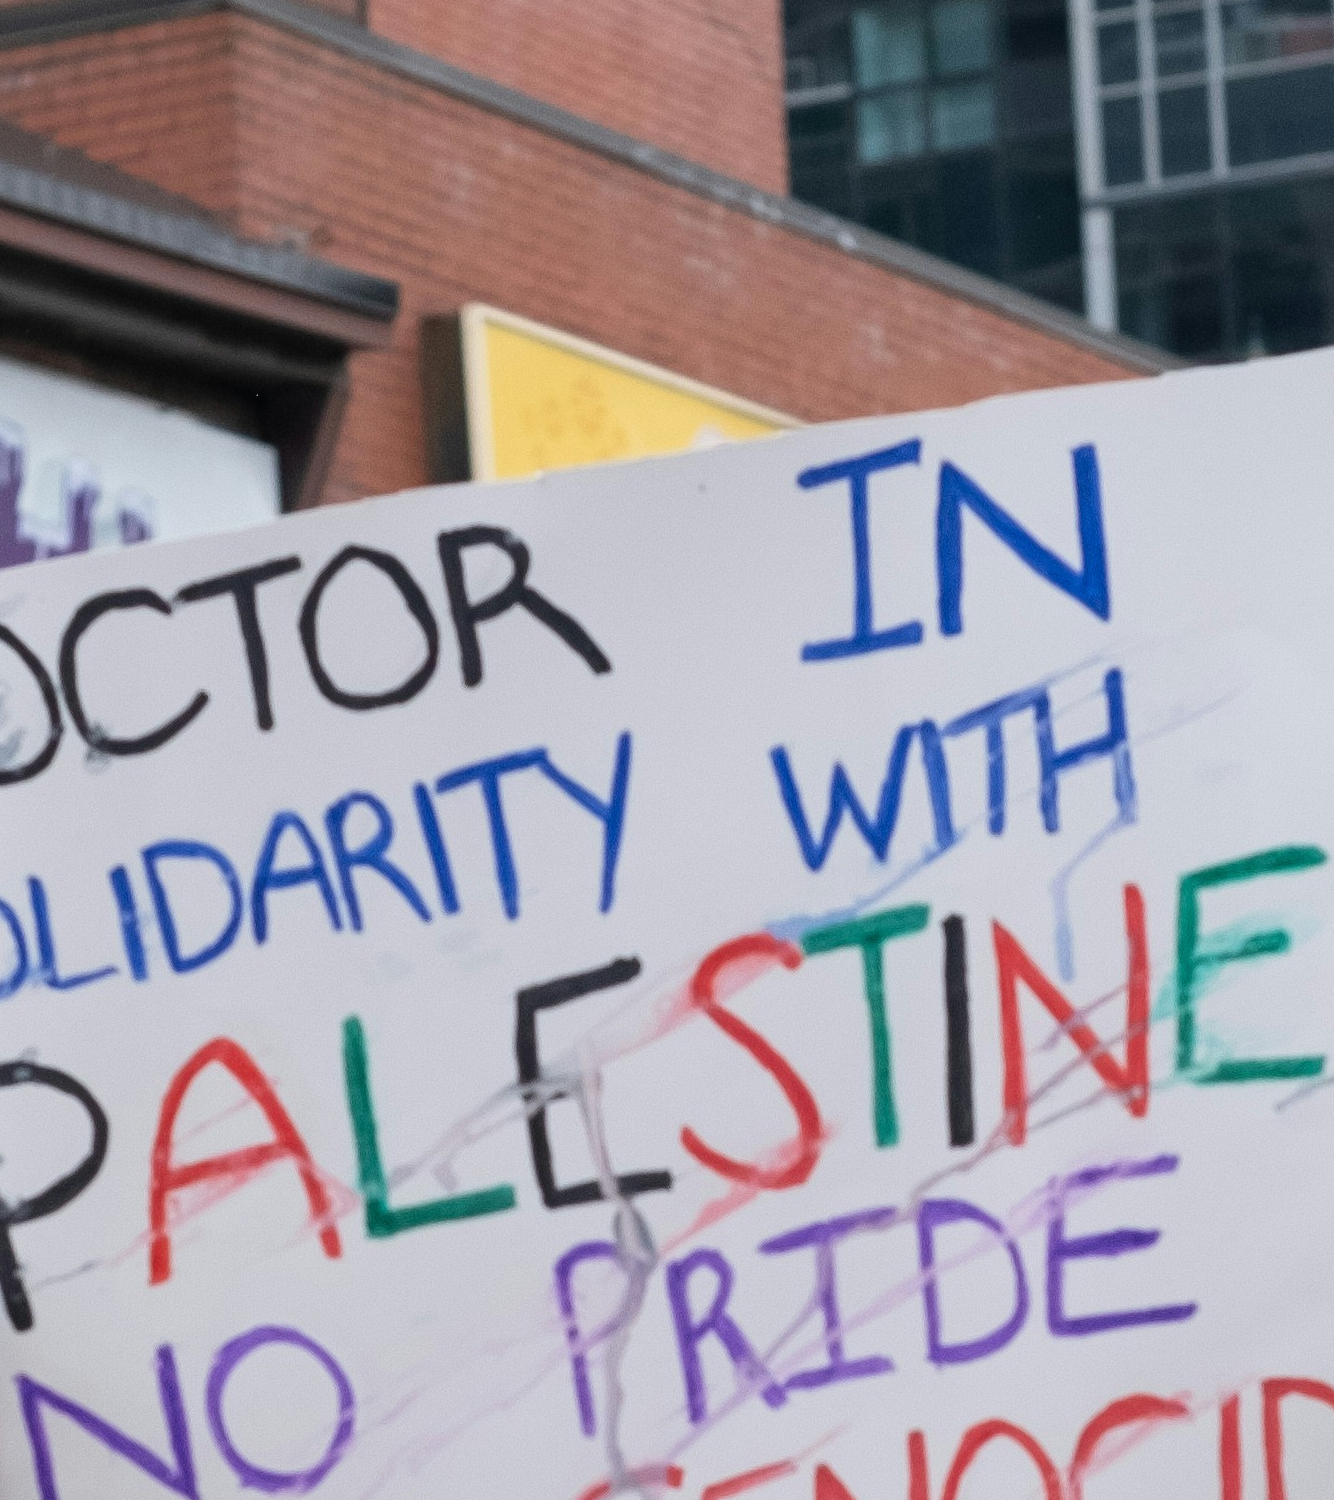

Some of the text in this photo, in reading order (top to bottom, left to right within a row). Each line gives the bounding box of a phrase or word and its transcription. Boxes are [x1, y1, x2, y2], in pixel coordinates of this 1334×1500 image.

[797, 438, 1111, 662] IN
[770, 667, 1137, 872] WITH
[555, 1155, 1197, 1437] PRIDE
